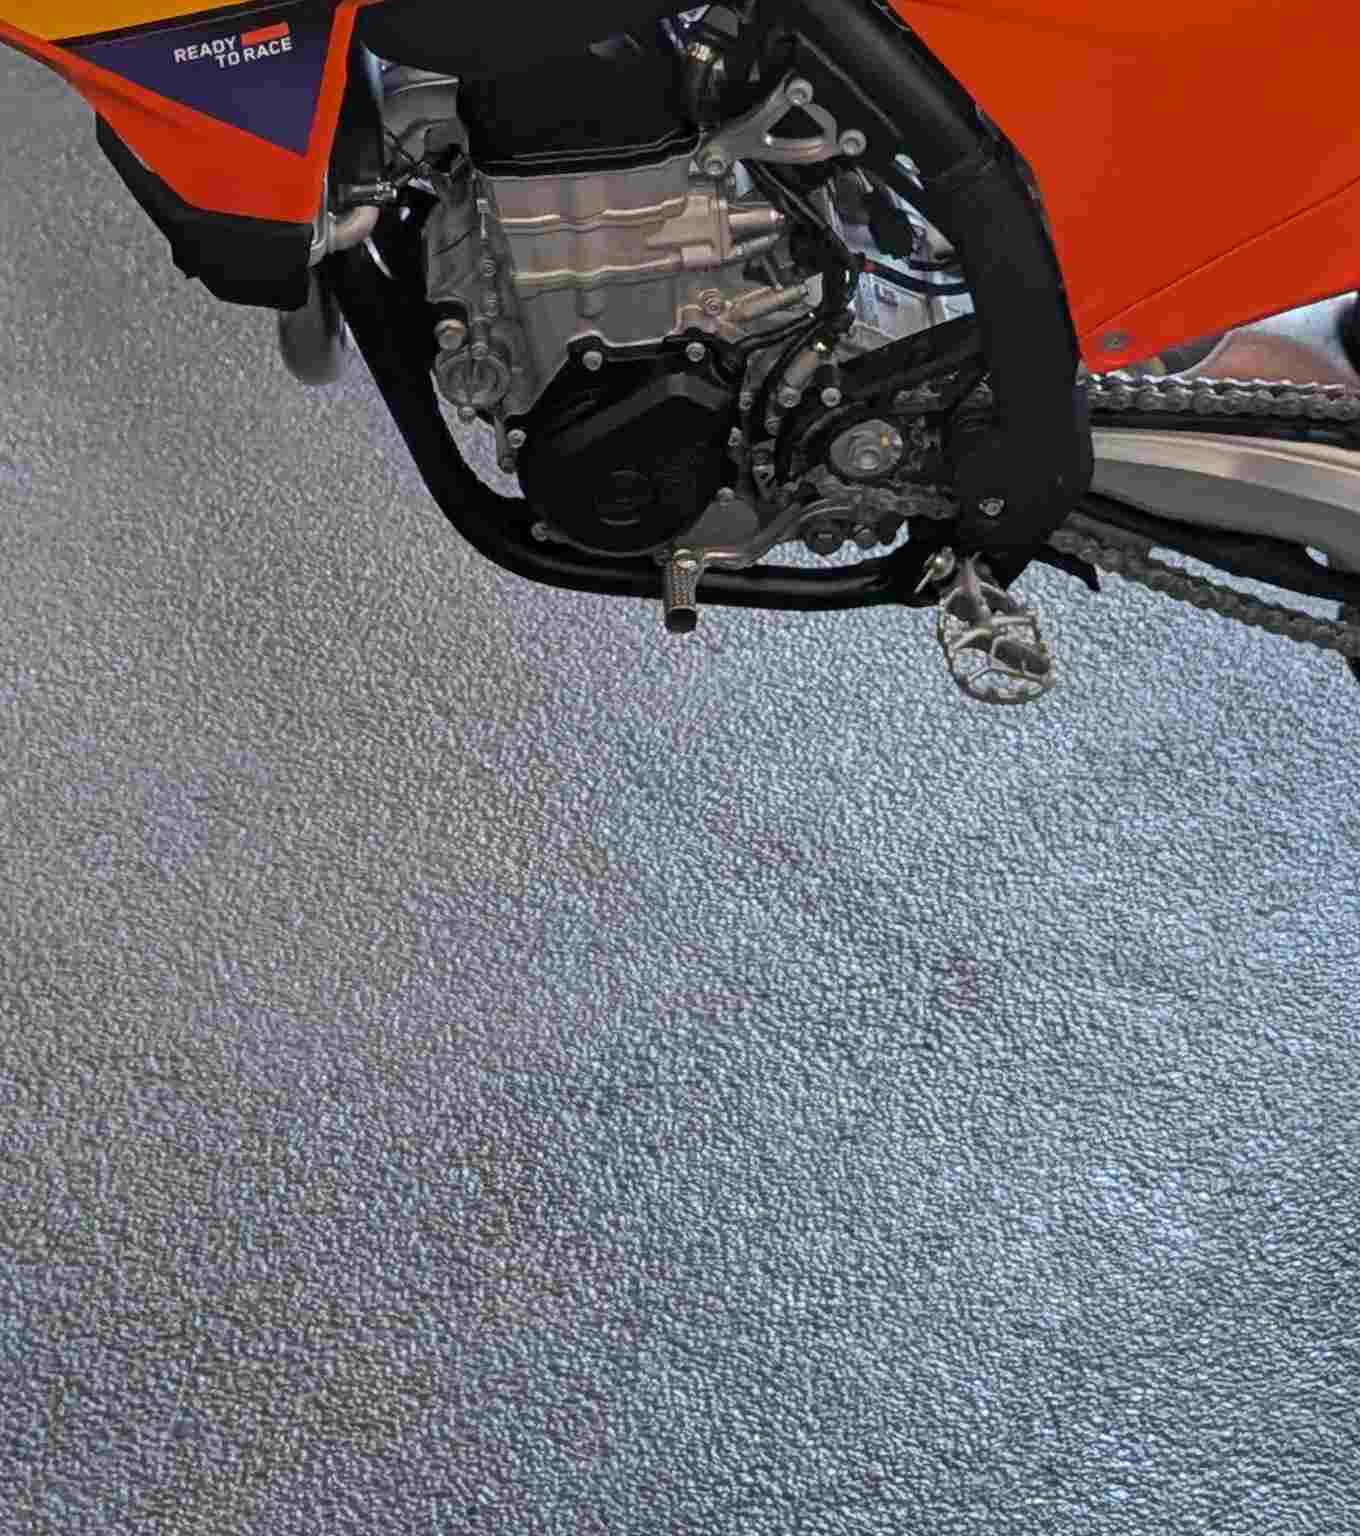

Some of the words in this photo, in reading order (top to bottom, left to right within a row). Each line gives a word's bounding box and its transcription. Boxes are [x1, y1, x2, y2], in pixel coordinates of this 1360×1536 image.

[173, 35, 237, 64] READY
[214, 50, 241, 69] TO
[242, 35, 294, 63] RACE
